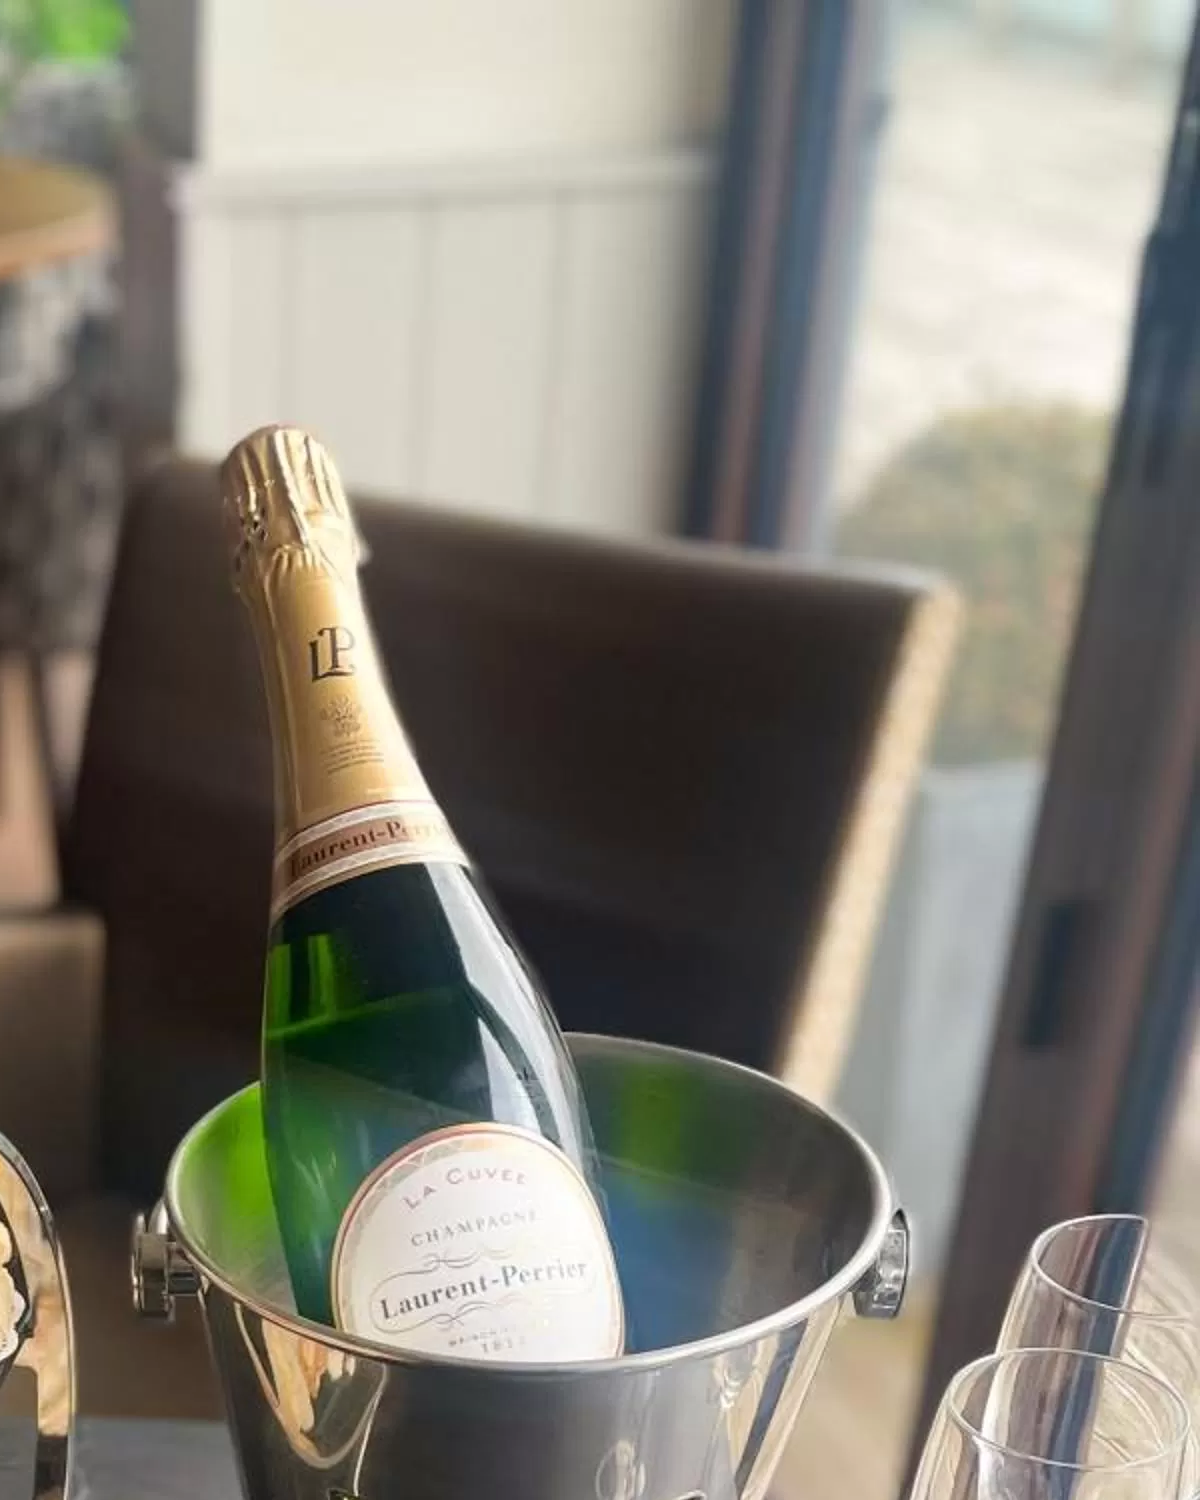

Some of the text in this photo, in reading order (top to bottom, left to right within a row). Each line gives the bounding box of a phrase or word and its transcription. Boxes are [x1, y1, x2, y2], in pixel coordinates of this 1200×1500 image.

[290, 818, 452, 878] Laurent-Perr
[403, 1185, 437, 1210] LA
[411, 1209, 536, 1247] CHAMPAGNE
[380, 1257, 588, 1321] Laurent-Perrier
